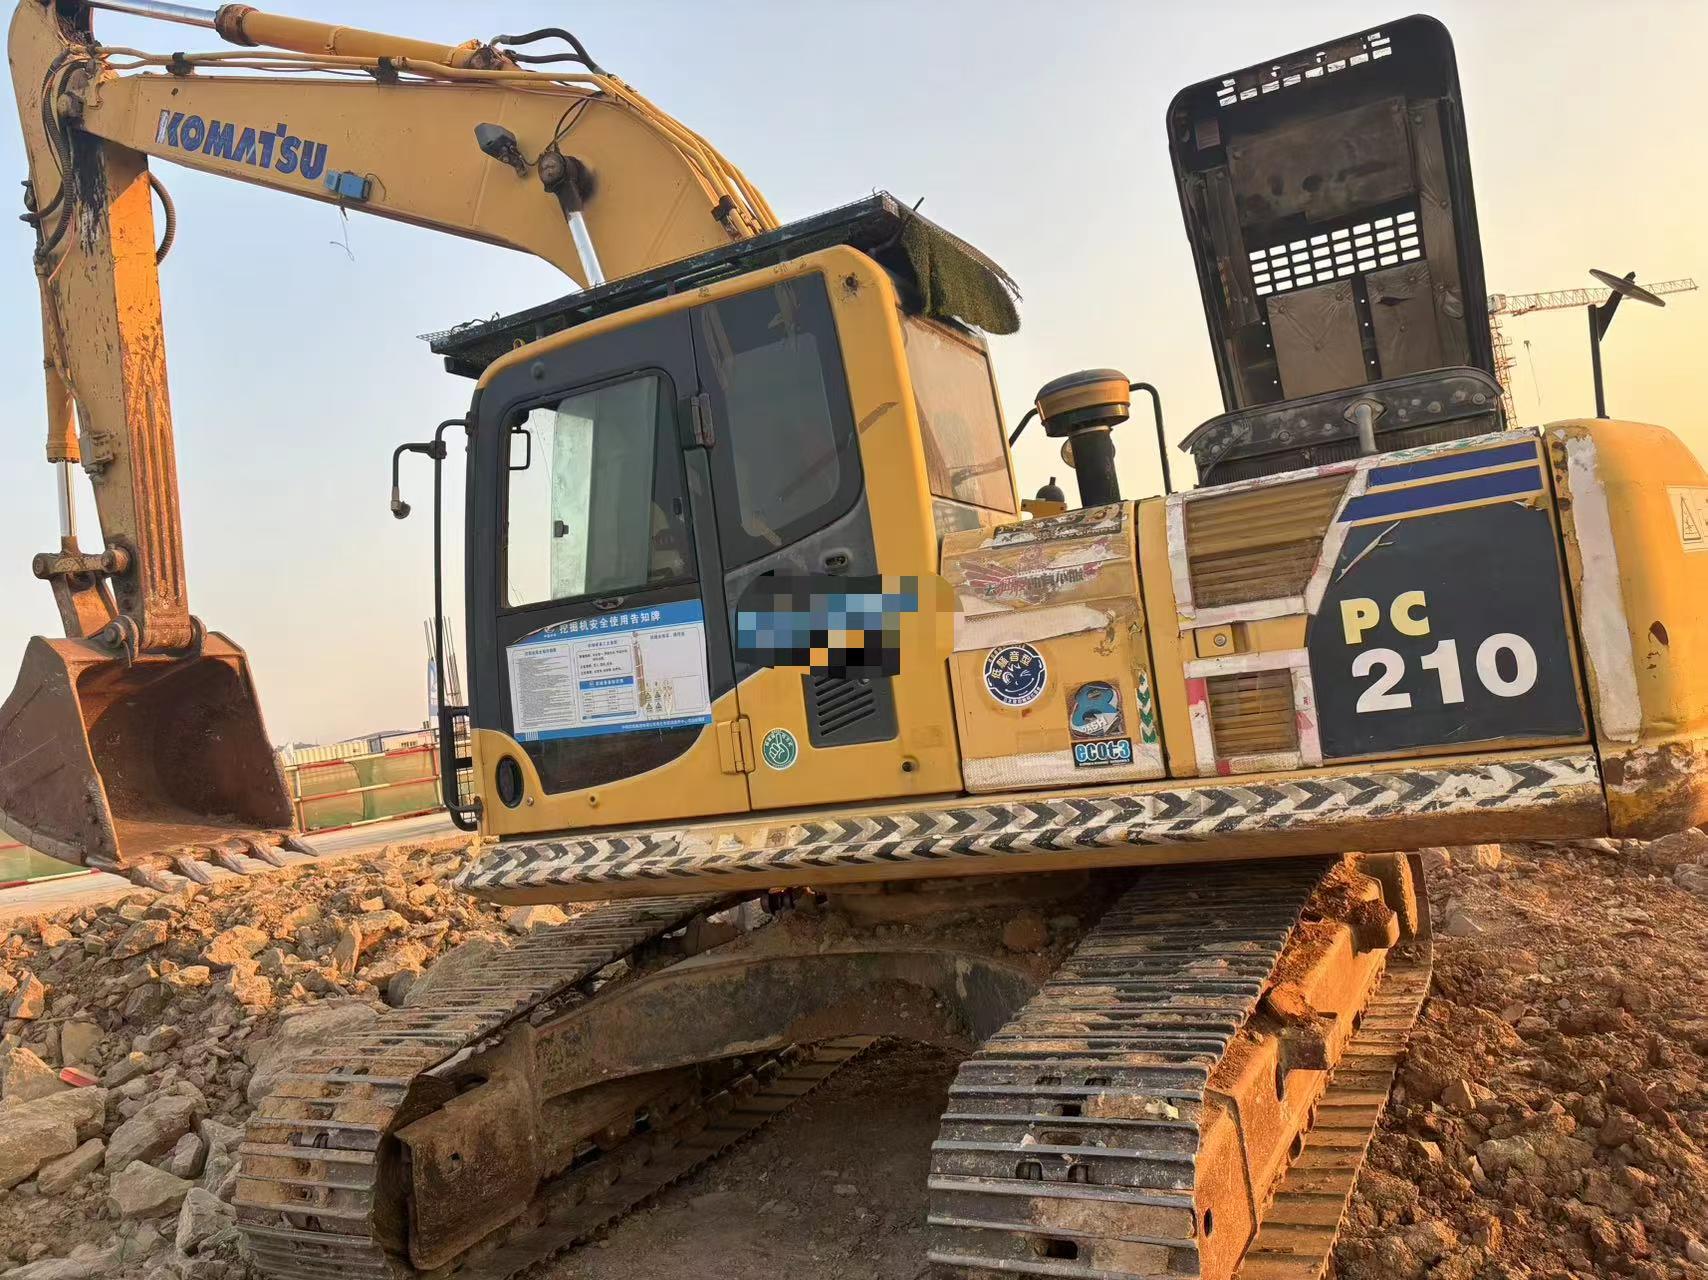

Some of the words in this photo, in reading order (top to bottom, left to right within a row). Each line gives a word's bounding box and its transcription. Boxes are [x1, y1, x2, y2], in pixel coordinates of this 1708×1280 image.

[155, 109, 328, 180] KOMATSU
[559, 611, 660, 634] 挖掘机安全使用告知牌
[1340, 590, 1430, 644] PC
[1352, 632, 1538, 713] 210
[1075, 740, 1131, 762] ecot3
